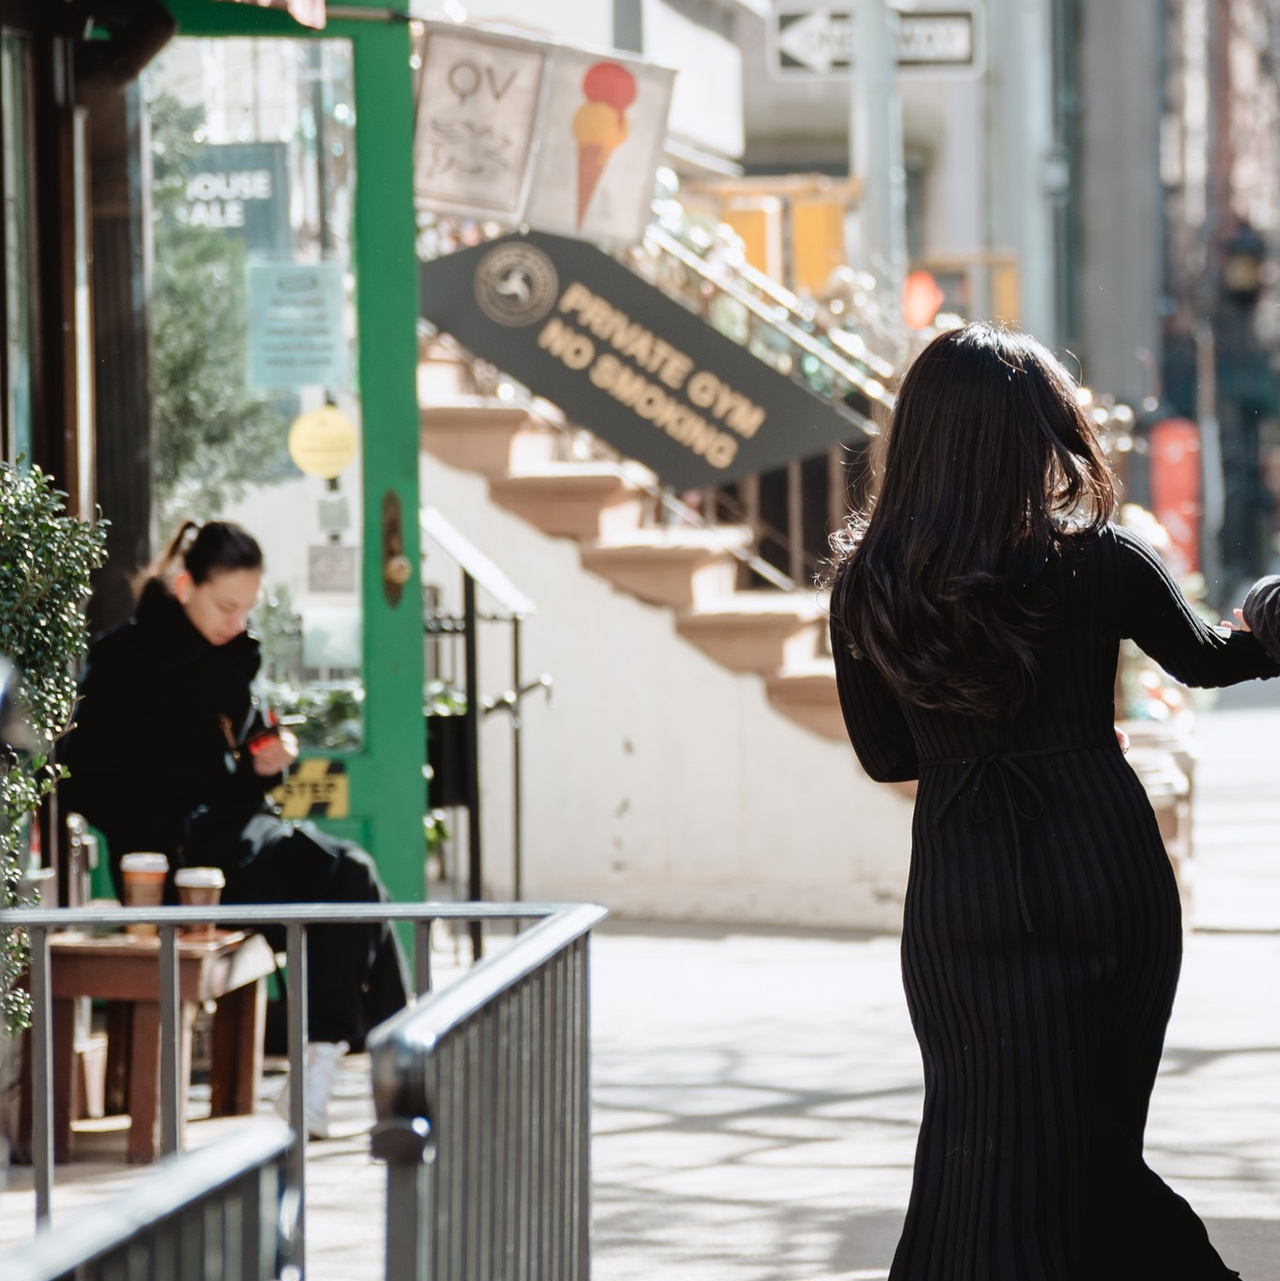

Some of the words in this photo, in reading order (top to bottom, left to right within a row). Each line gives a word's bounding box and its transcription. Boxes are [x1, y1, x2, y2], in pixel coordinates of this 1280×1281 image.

[536, 317, 596, 370] NO
[588, 353, 739, 470] SMOKING
[558, 280, 694, 390] PRIVATE
[686, 370, 767, 439] GYM
